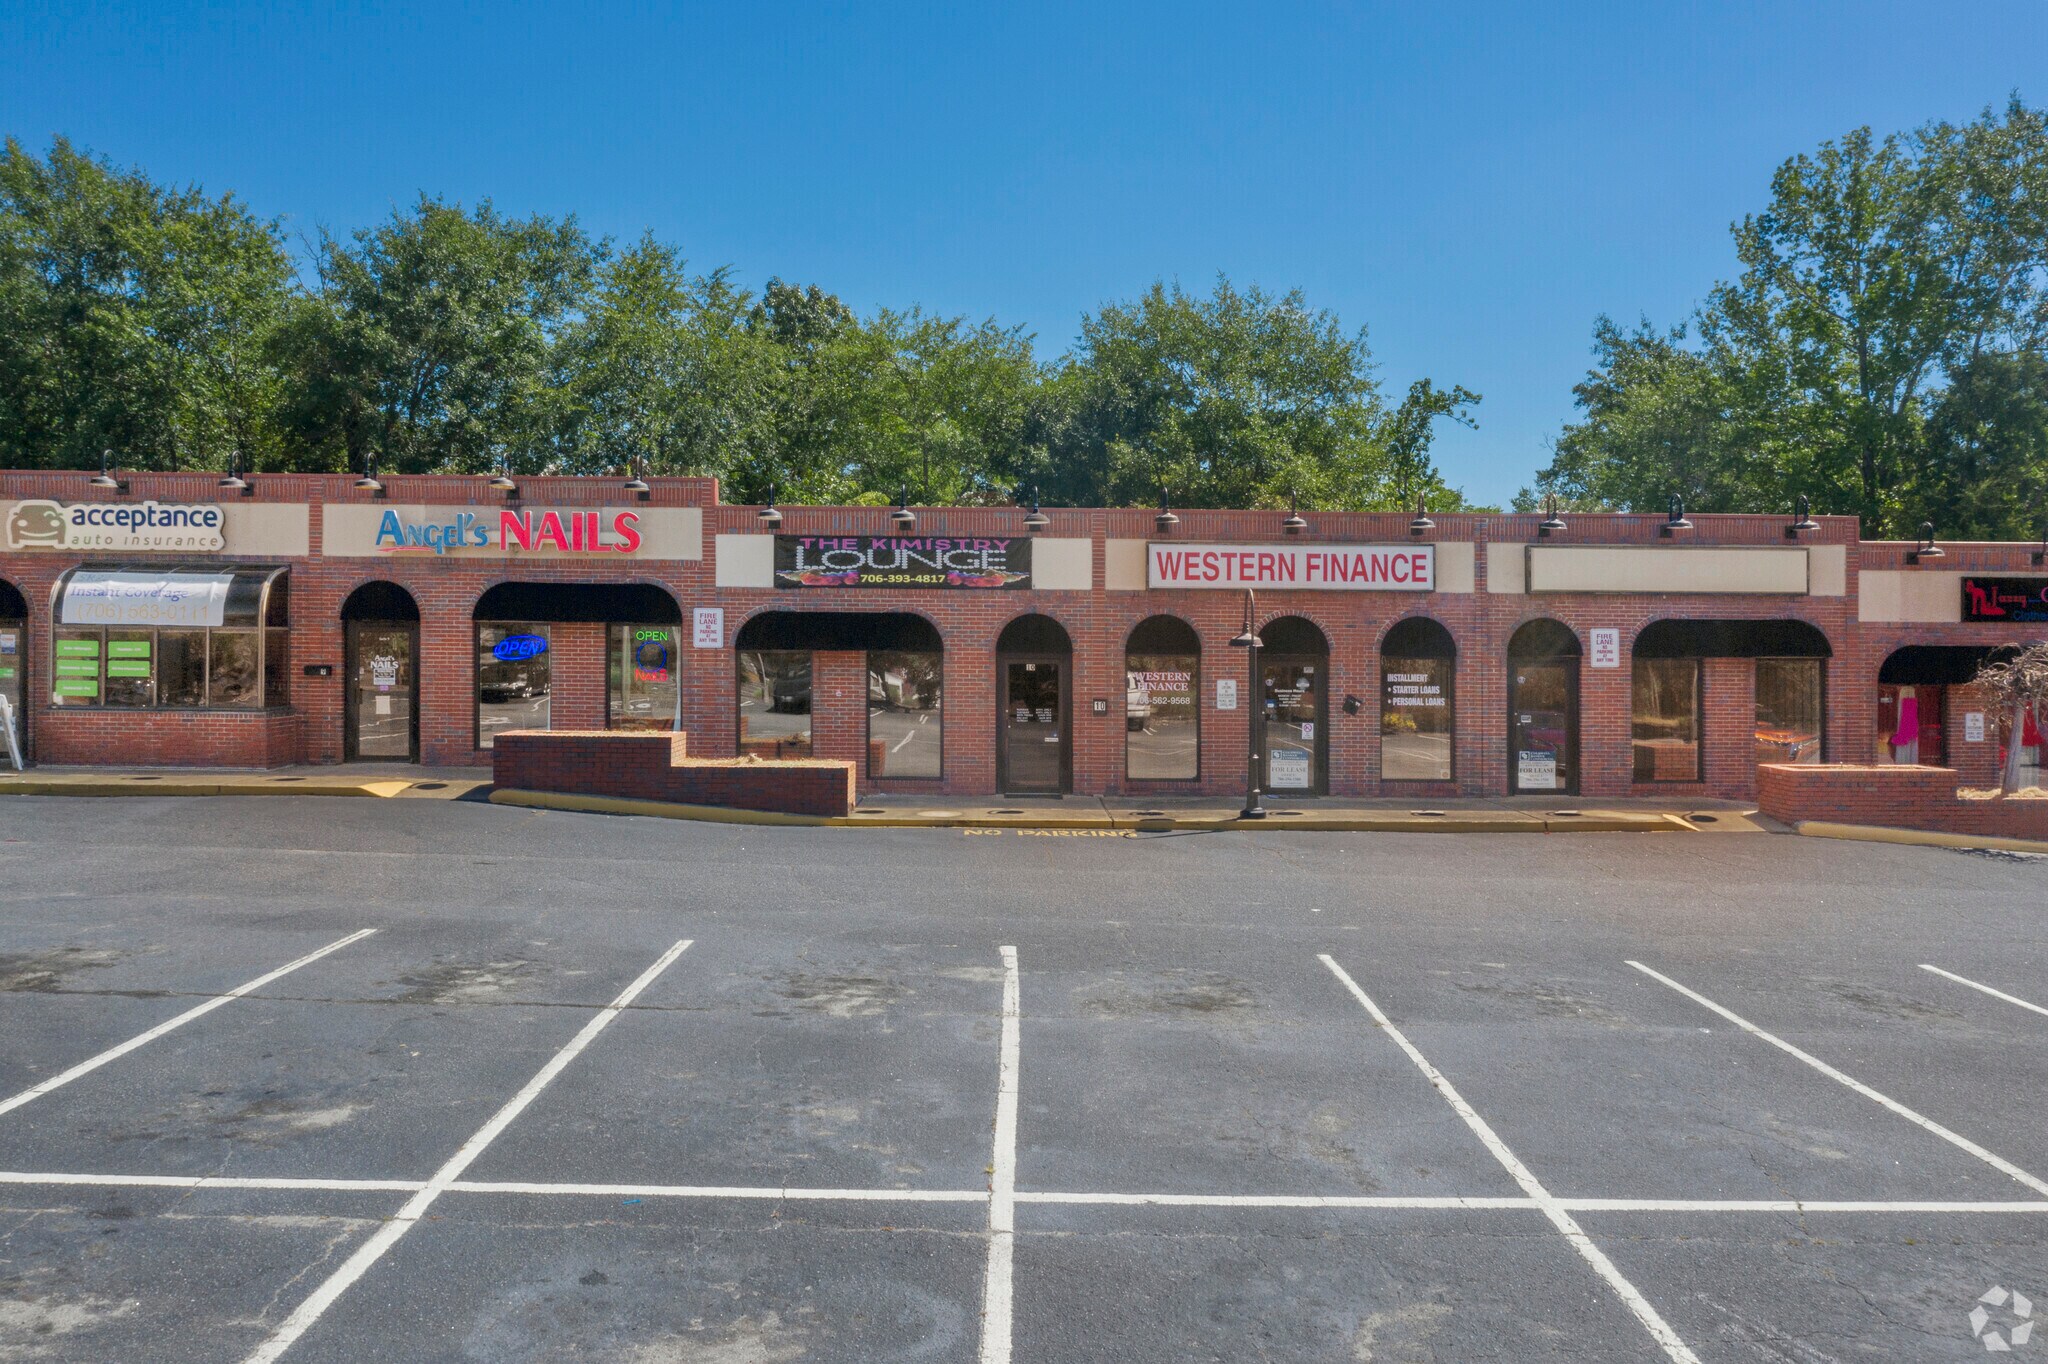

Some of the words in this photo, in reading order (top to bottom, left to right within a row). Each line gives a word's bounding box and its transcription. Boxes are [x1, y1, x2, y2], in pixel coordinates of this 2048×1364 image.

[72, 506, 218, 533] acceptance
[499, 510, 642, 554] NAILS
[71, 536, 114, 545] auto
[125, 536, 218, 546] insurance
[799, 538, 858, 550] THE
[871, 538, 1011, 551] KIMISTRY
[796, 545, 1007, 570] LOUNGE
[1156, 551, 1296, 582] WESTERN
[1305, 553, 1428, 583] FINANCE
[860, 574, 946, 583] 706-393-4817
[70, 586, 120, 598] Instant
[125, 588, 189, 602] Coverage
[76, 603, 123, 624] (706)
[635, 631, 668, 641] OPEN
[500, 639, 540, 656] OPEN
[370, 661, 399, 669] NAILS
[635, 668, 668, 682] NAILS
[1134, 671, 1191, 681] WESTERN
[1387, 673, 1429, 682] INSTALLMENT
[1137, 682, 1189, 691] FINANCE
[1392, 685, 1419, 694] STARTER
[1420, 686, 1440, 694] LOANS
[1094, 701, 1106, 711] 10
[1392, 698, 1421, 706] PERSONAL
[1425, 698, 1446, 706] LOANS
[1017, 829, 1137, 837] PARKING
